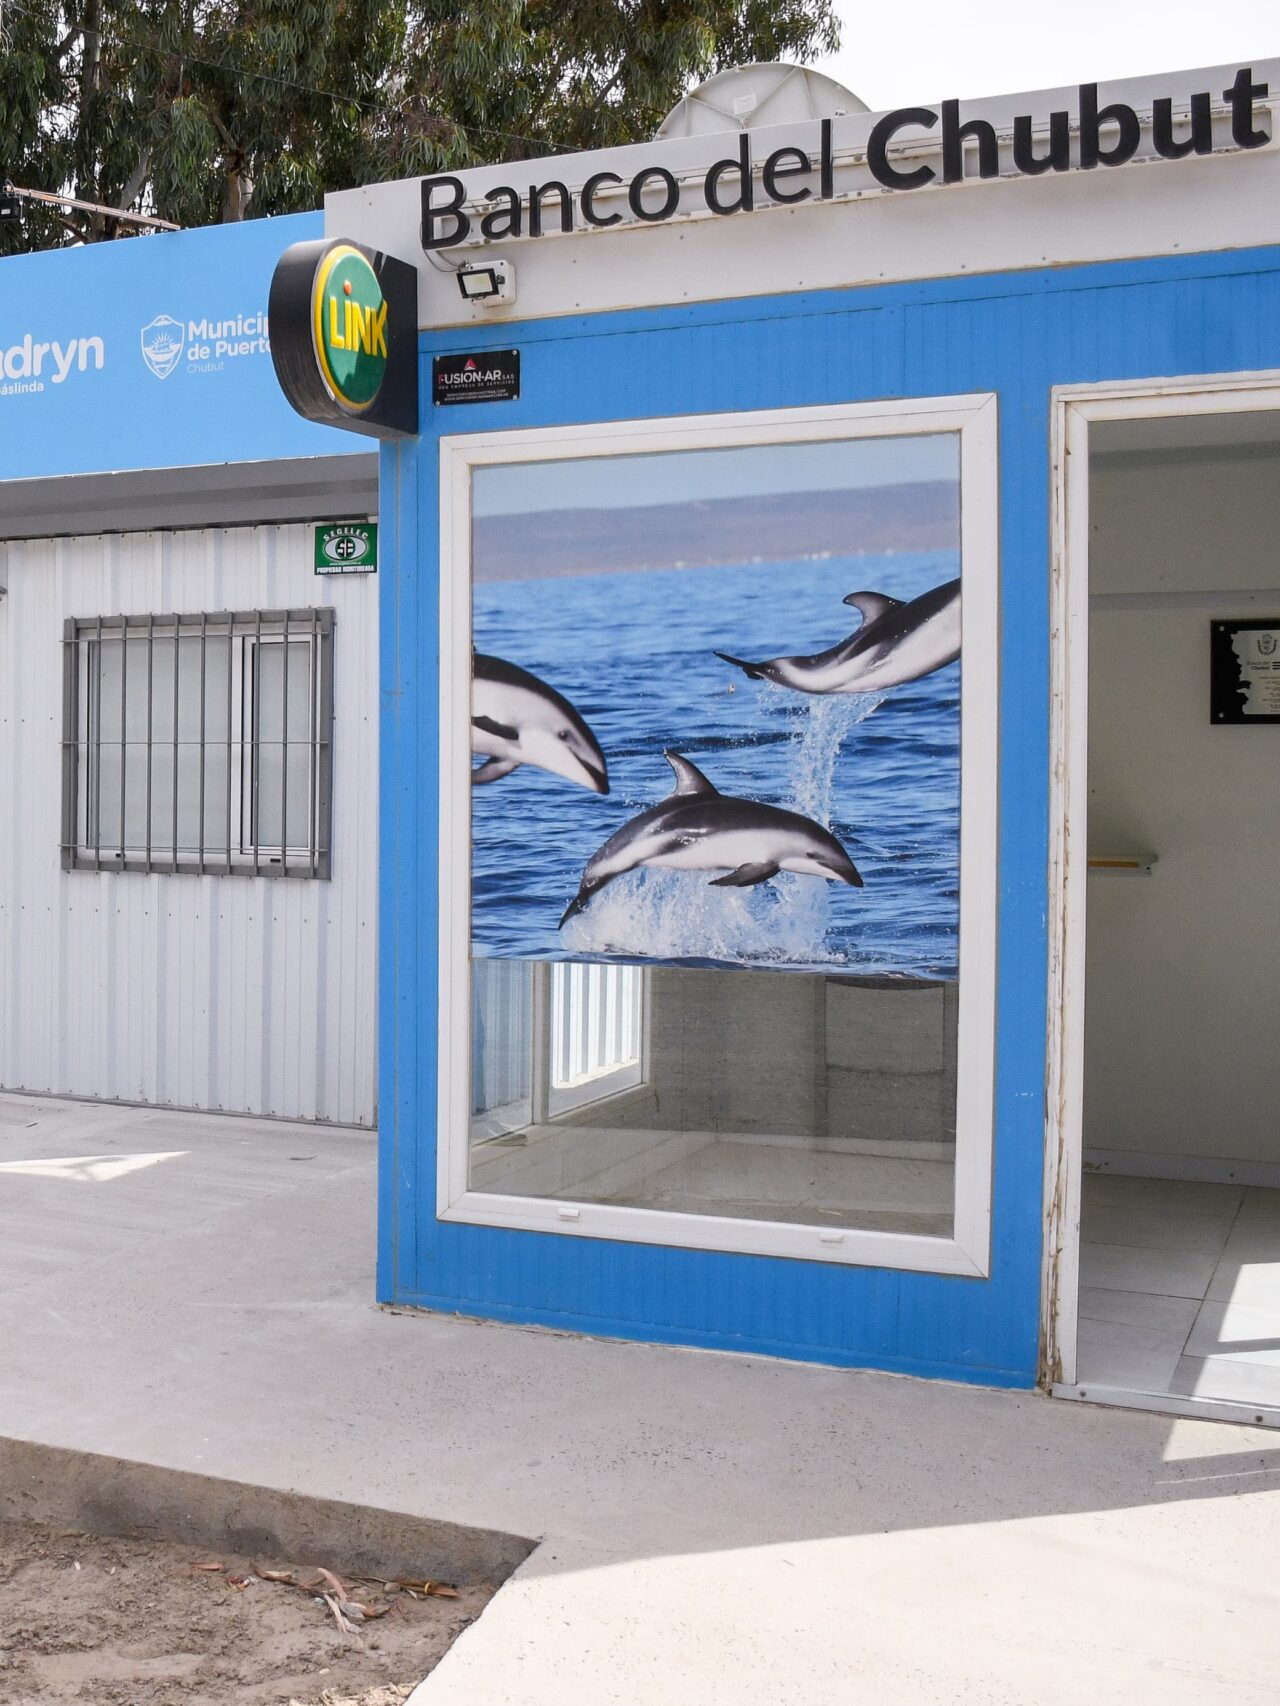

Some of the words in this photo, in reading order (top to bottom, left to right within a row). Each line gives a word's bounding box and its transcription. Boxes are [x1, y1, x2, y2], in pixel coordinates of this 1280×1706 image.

[420, 167, 681, 250] Banco
[704, 118, 834, 216] del
[867, 67, 1271, 192] Chubut
[330, 296, 387, 359] LINK
[186, 361, 225, 374] Chubut
[187, 343, 210, 361] de
